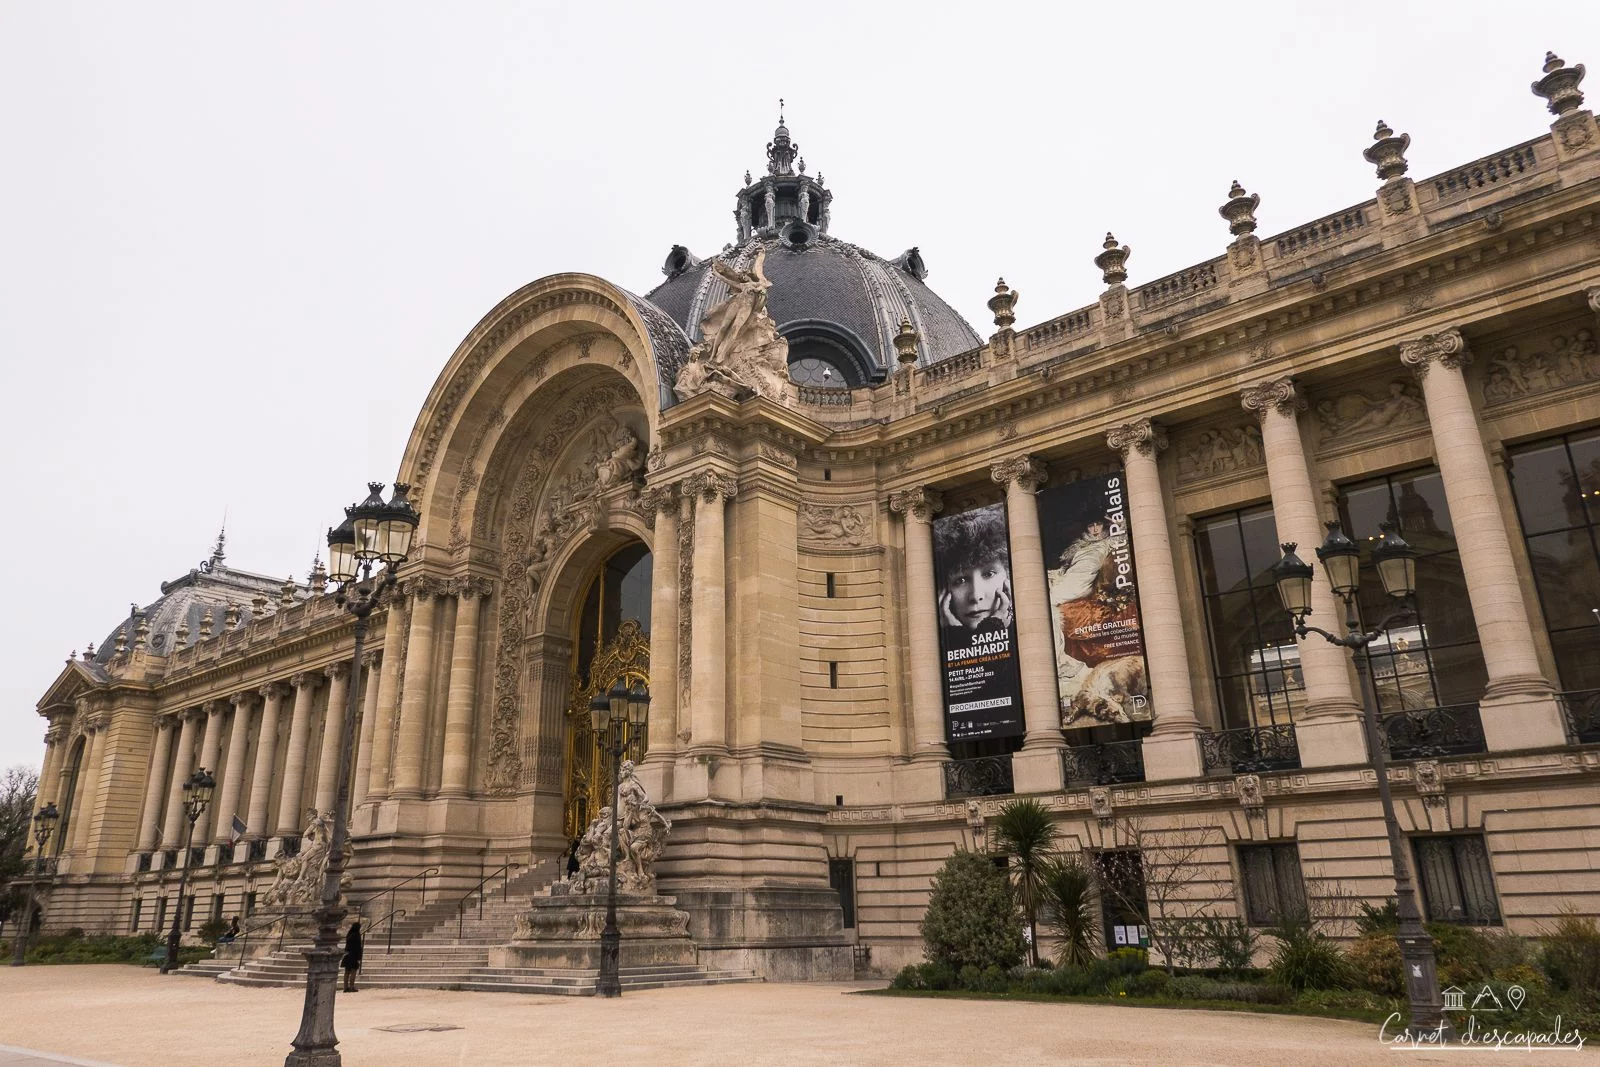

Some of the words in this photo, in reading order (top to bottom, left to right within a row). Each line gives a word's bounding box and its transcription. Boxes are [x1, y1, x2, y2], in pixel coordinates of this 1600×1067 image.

[1104, 477, 1126, 537] Palais
[1111, 539, 1133, 590] Petit
[1074, 622, 1102, 635] ENTRÉE
[1102, 617, 1137, 630] GRATUITE
[971, 628, 1009, 646] SARAH
[1115, 639, 1140, 647] ENTRANCE
[947, 640, 1010, 661] BERNHARDT
[960, 658, 979, 666] FEMME
[948, 669, 964, 678] PETIT
[964, 665, 985, 676] PALAIS
[950, 697, 1010, 712] PROCHAINEMENT
